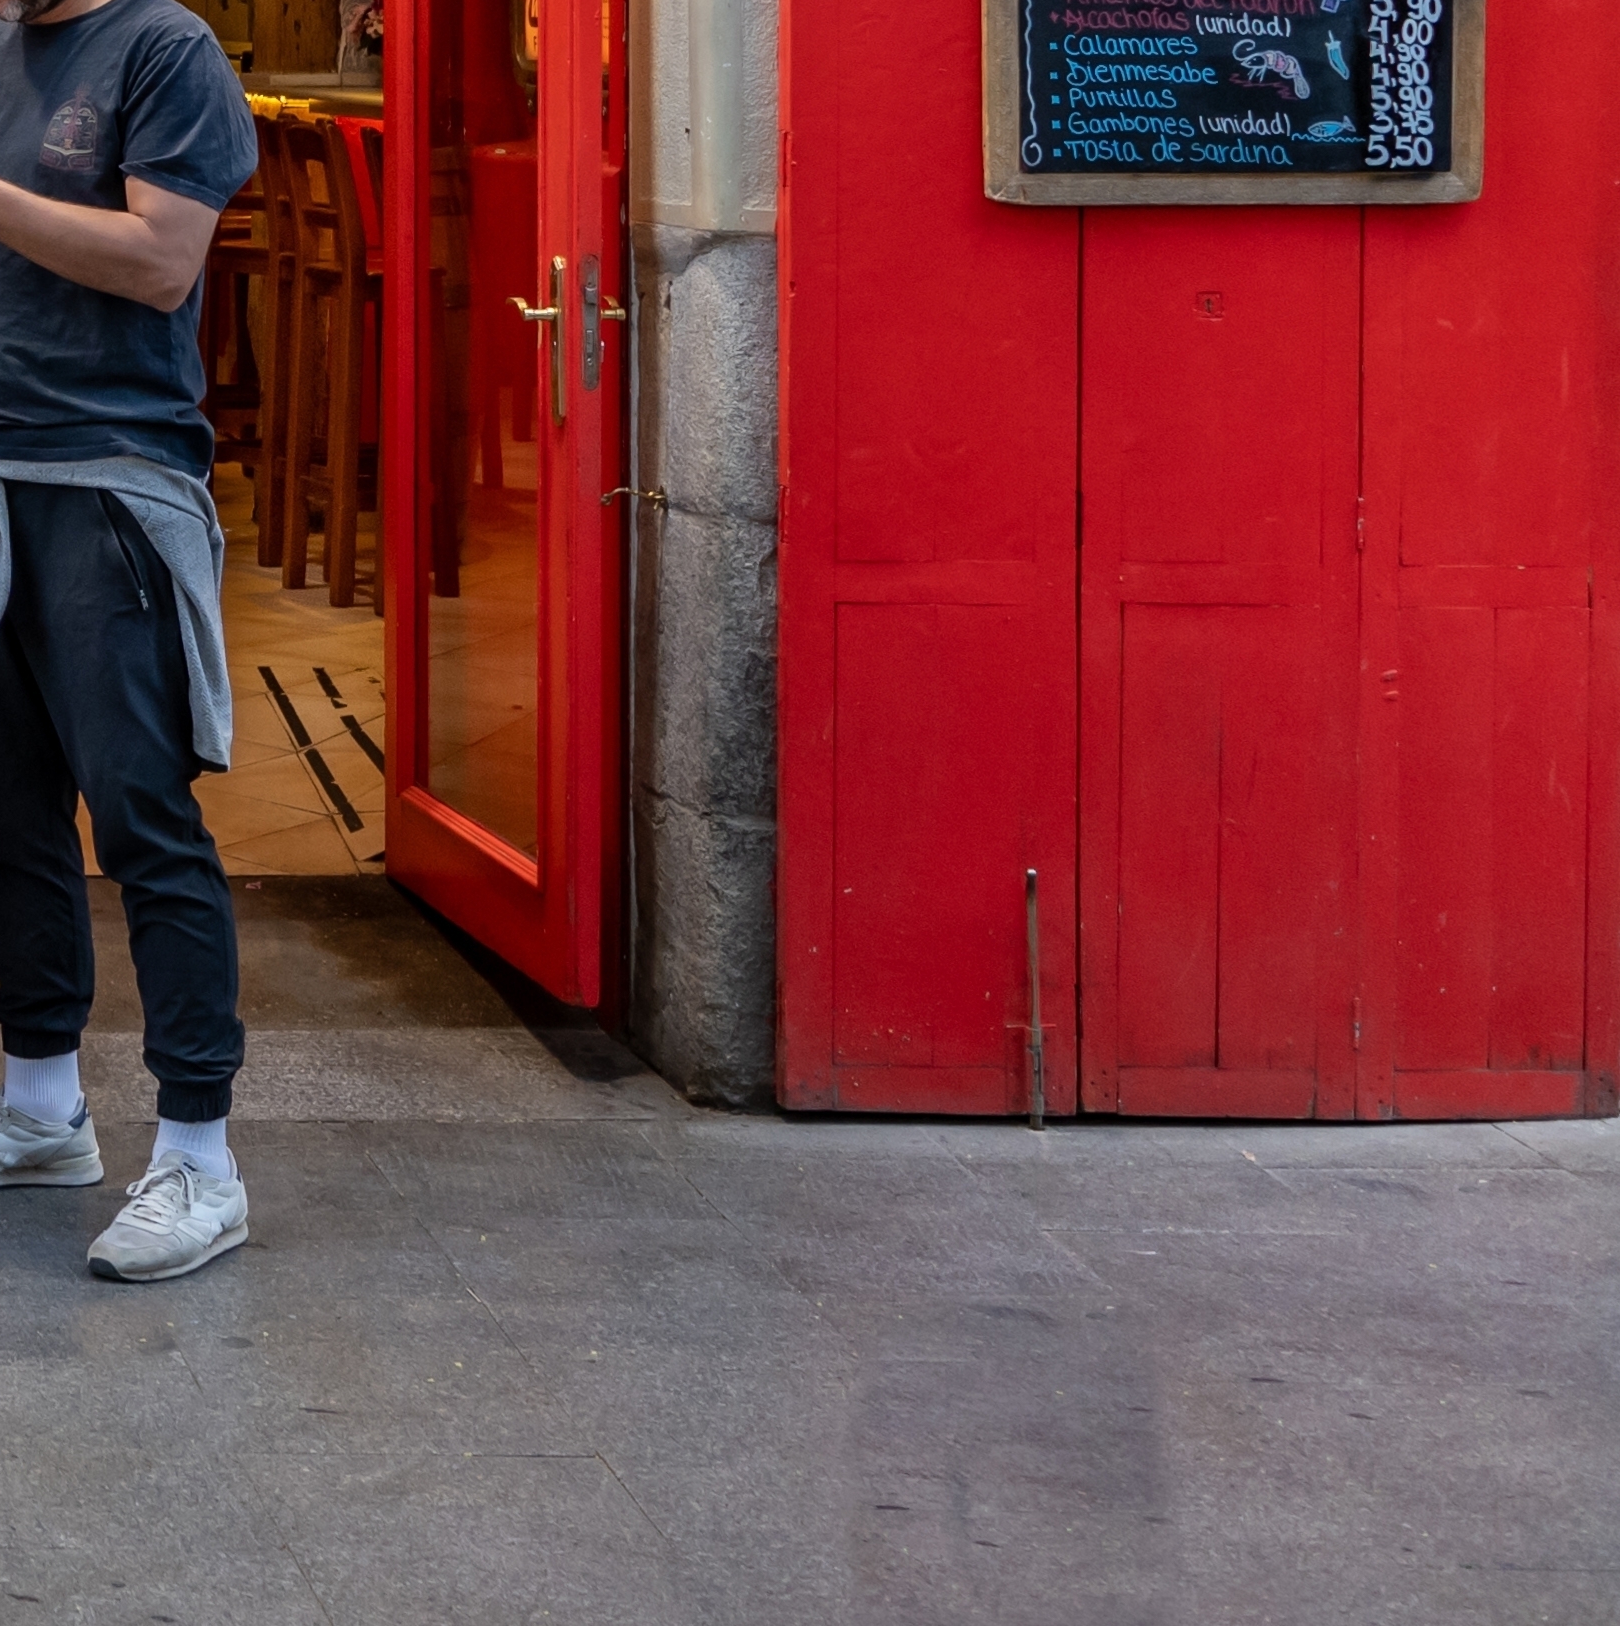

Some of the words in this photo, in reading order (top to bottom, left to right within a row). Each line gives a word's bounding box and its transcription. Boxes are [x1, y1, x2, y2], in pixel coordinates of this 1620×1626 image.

[1195, 11, 1292, 37] (unidad)
[1368, 16, 1435, 46] 4,00
[1064, 35, 1198, 57] Calamares
[1067, 60, 1218, 86] Bienmesabe
[1371, 60, 1430, 87] 4,90
[1070, 88, 1177, 110] Puntillas
[1370, 85, 1433, 113] 5,90
[1067, 112, 1195, 137] Gambones
[1199, 110, 1292, 136] (unidad)
[1152, 139, 1183, 162] de
[1190, 140, 1292, 165] sardina
[1365, 135, 1433, 168] 5,50
